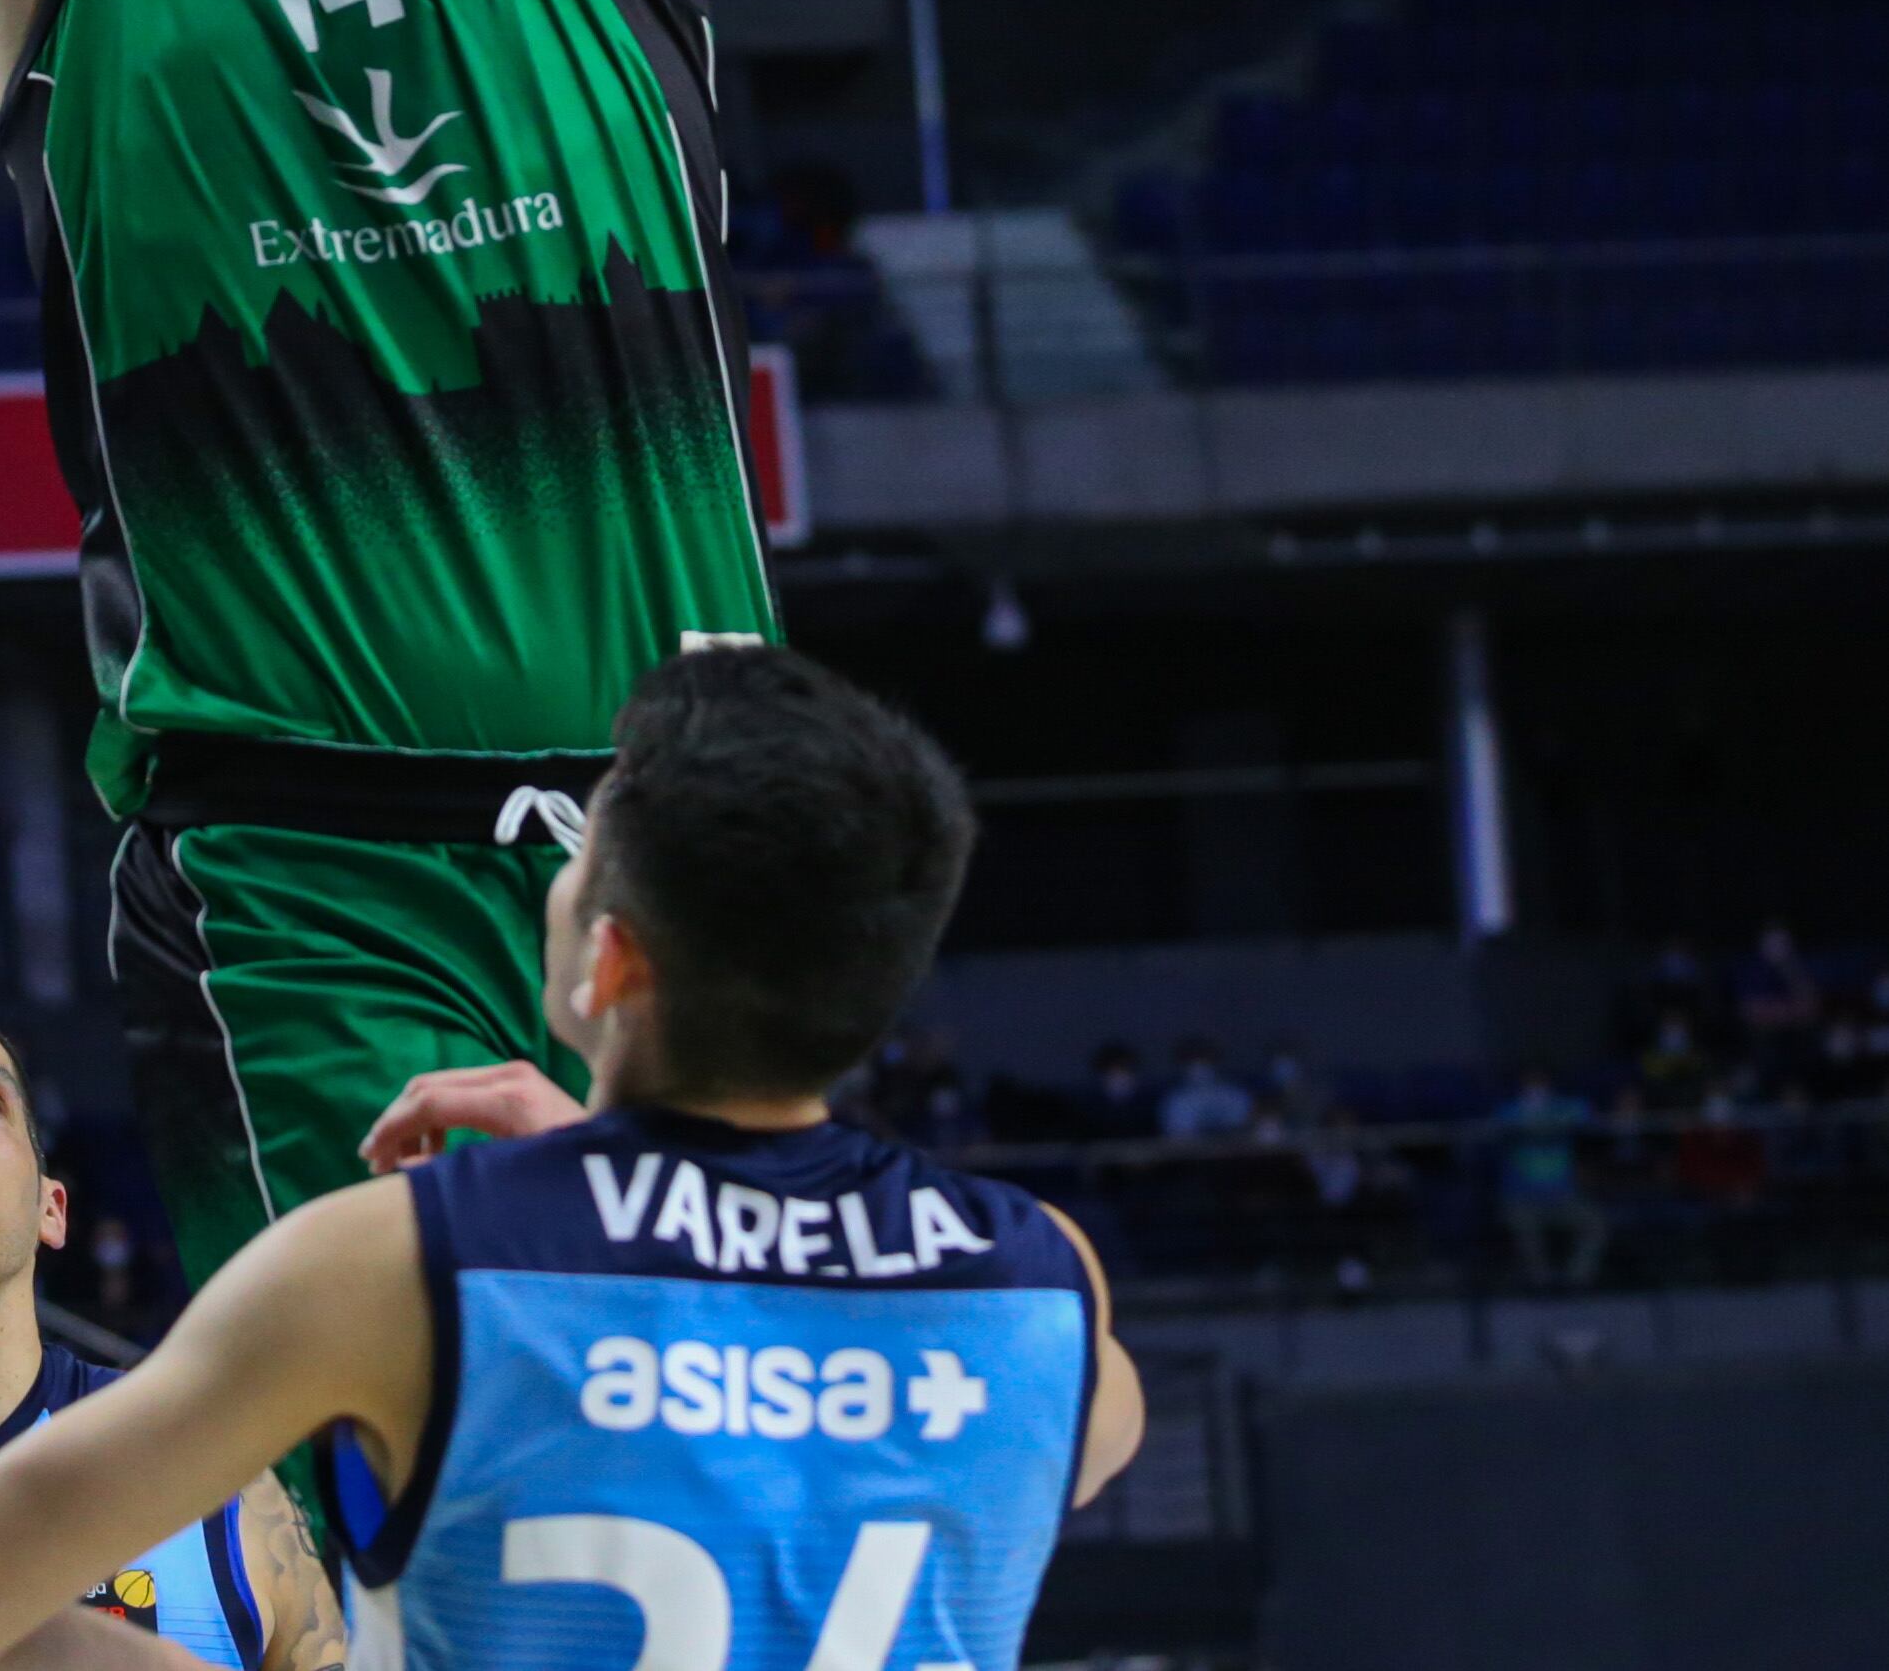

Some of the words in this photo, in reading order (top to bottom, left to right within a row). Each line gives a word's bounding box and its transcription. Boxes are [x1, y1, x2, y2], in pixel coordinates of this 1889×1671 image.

[249, 191, 564, 269] Extremadura
[581, 1151, 995, 1278] VARELA
[580, 1336, 895, 1443] asisa
[86, 1582, 108, 1599] ga
